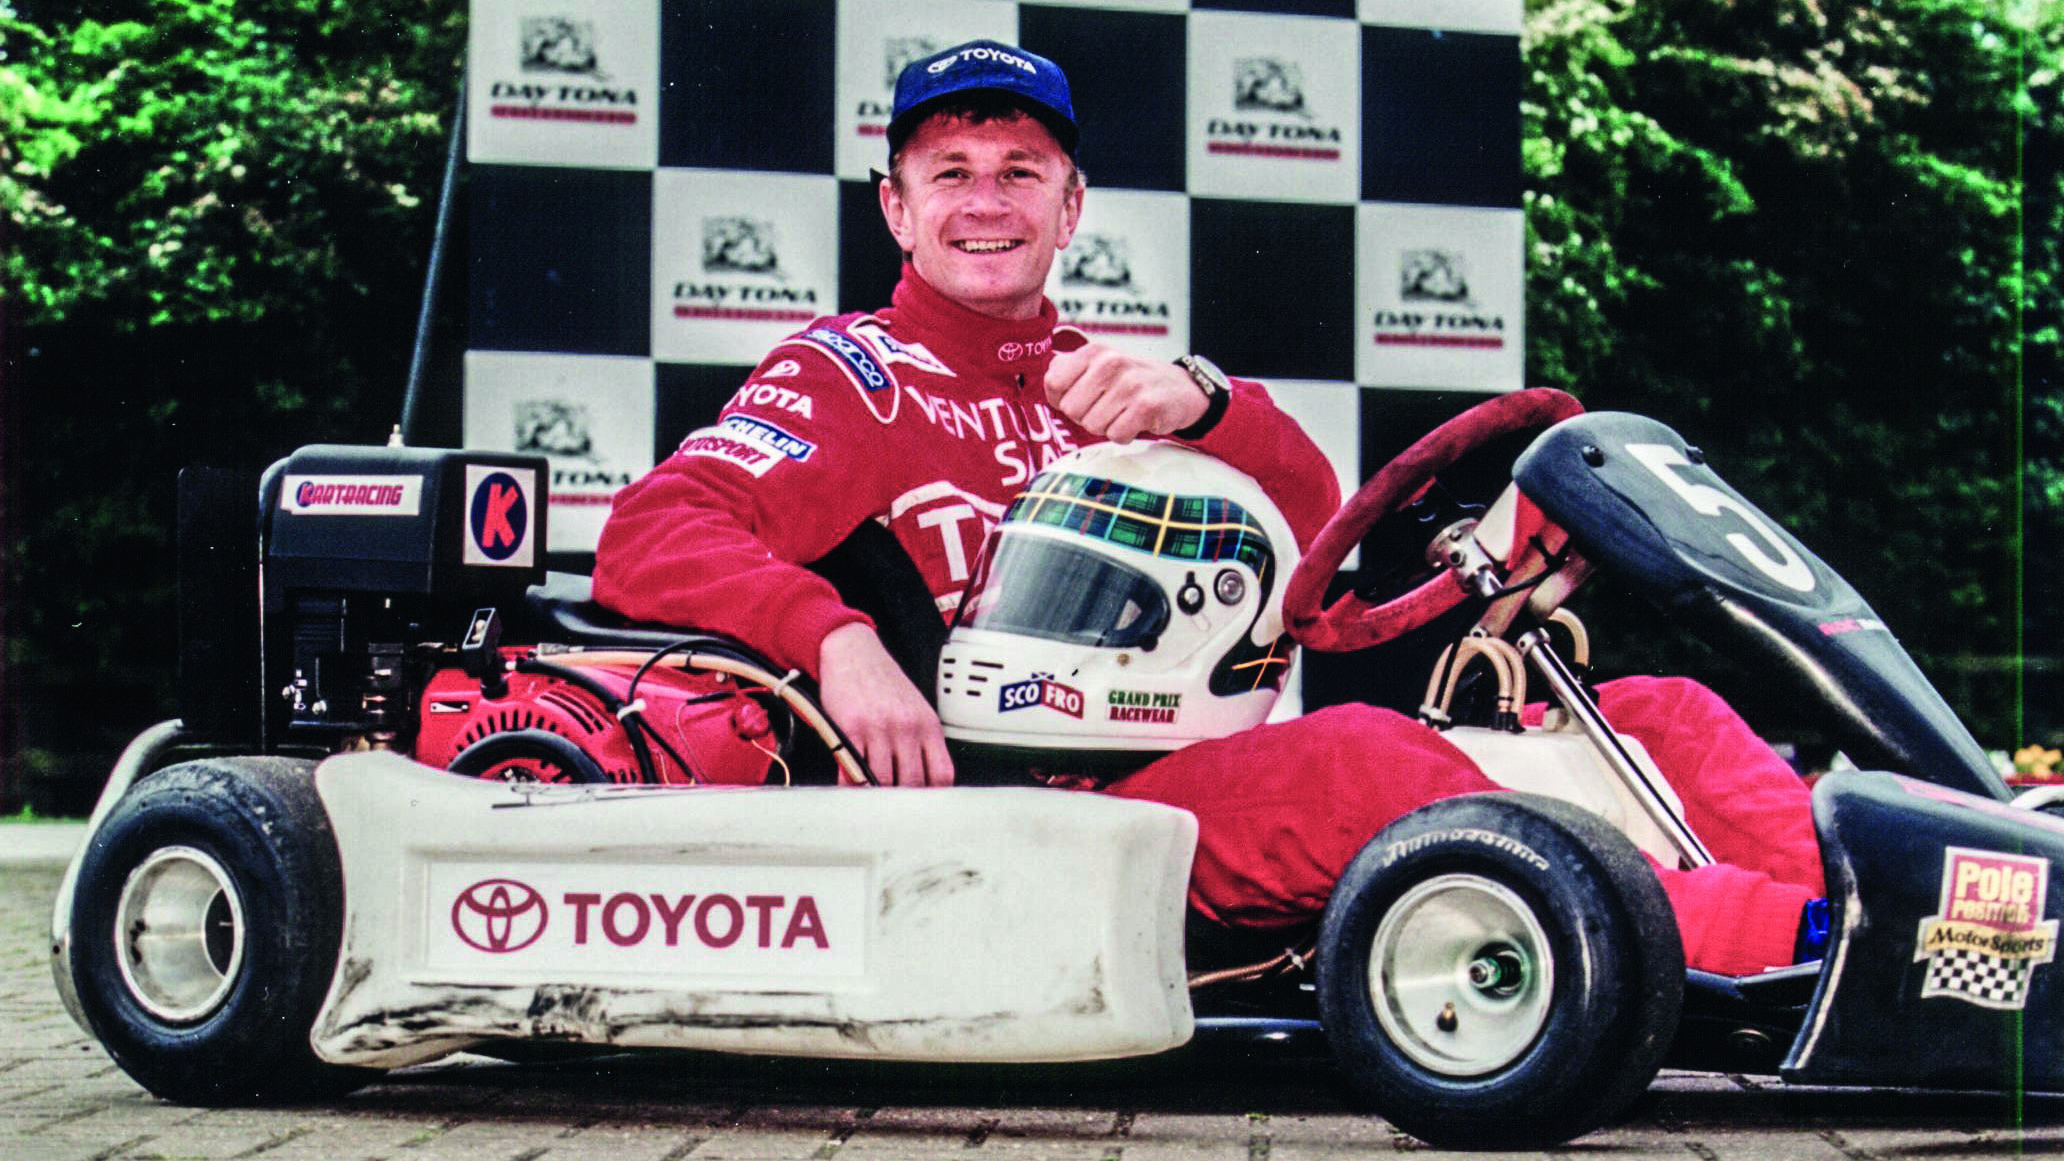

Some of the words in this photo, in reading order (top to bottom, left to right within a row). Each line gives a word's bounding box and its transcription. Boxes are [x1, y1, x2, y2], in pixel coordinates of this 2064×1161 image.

[959, 47, 1037, 75] TOYOTA
[491, 82, 638, 105] DAYTONA
[1206, 119, 1341, 142] DAYTONA
[673, 282, 817, 303] DAYTONA
[1057, 299, 1169, 317] AYTONA
[1374, 311, 1504, 332] DAYTONA
[738, 383, 813, 420] YOTA
[553, 470, 631, 486] TONA
[482, 482, 519, 548] K
[1624, 443, 1816, 592] 5
[1004, 683, 1039, 709] SCO
[1045, 685, 1080, 713] FRO
[1108, 690, 1150, 706] GRAND
[1152, 693, 1181, 708] PRIX
[1109, 706, 1175, 723] RACEWEAR
[1954, 861, 2035, 904] Pole
[563, 891, 830, 950] TOYOTA
